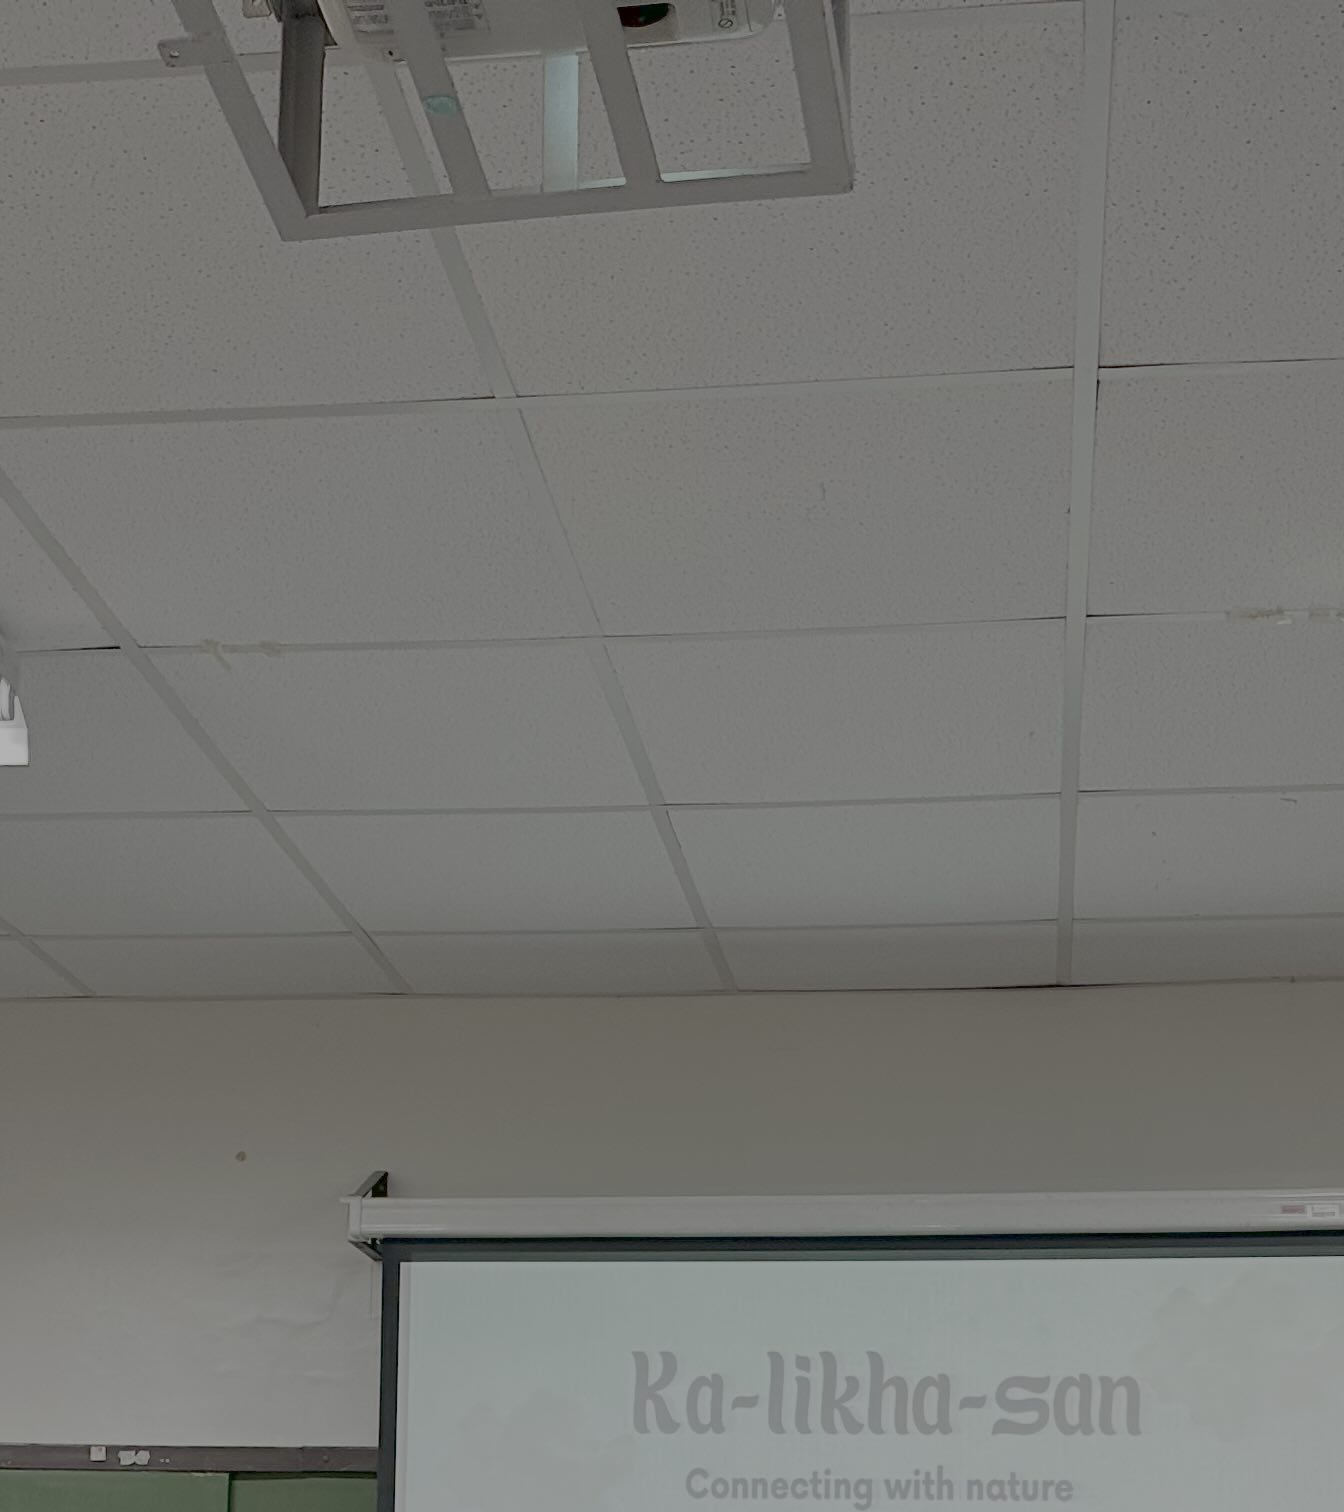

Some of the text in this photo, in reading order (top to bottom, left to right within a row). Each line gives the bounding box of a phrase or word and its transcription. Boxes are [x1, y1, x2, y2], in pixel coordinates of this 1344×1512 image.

[630, 1350, 1143, 1437] Ka-likha-san
[685, 1466, 1074, 1511] Connecting with nature
